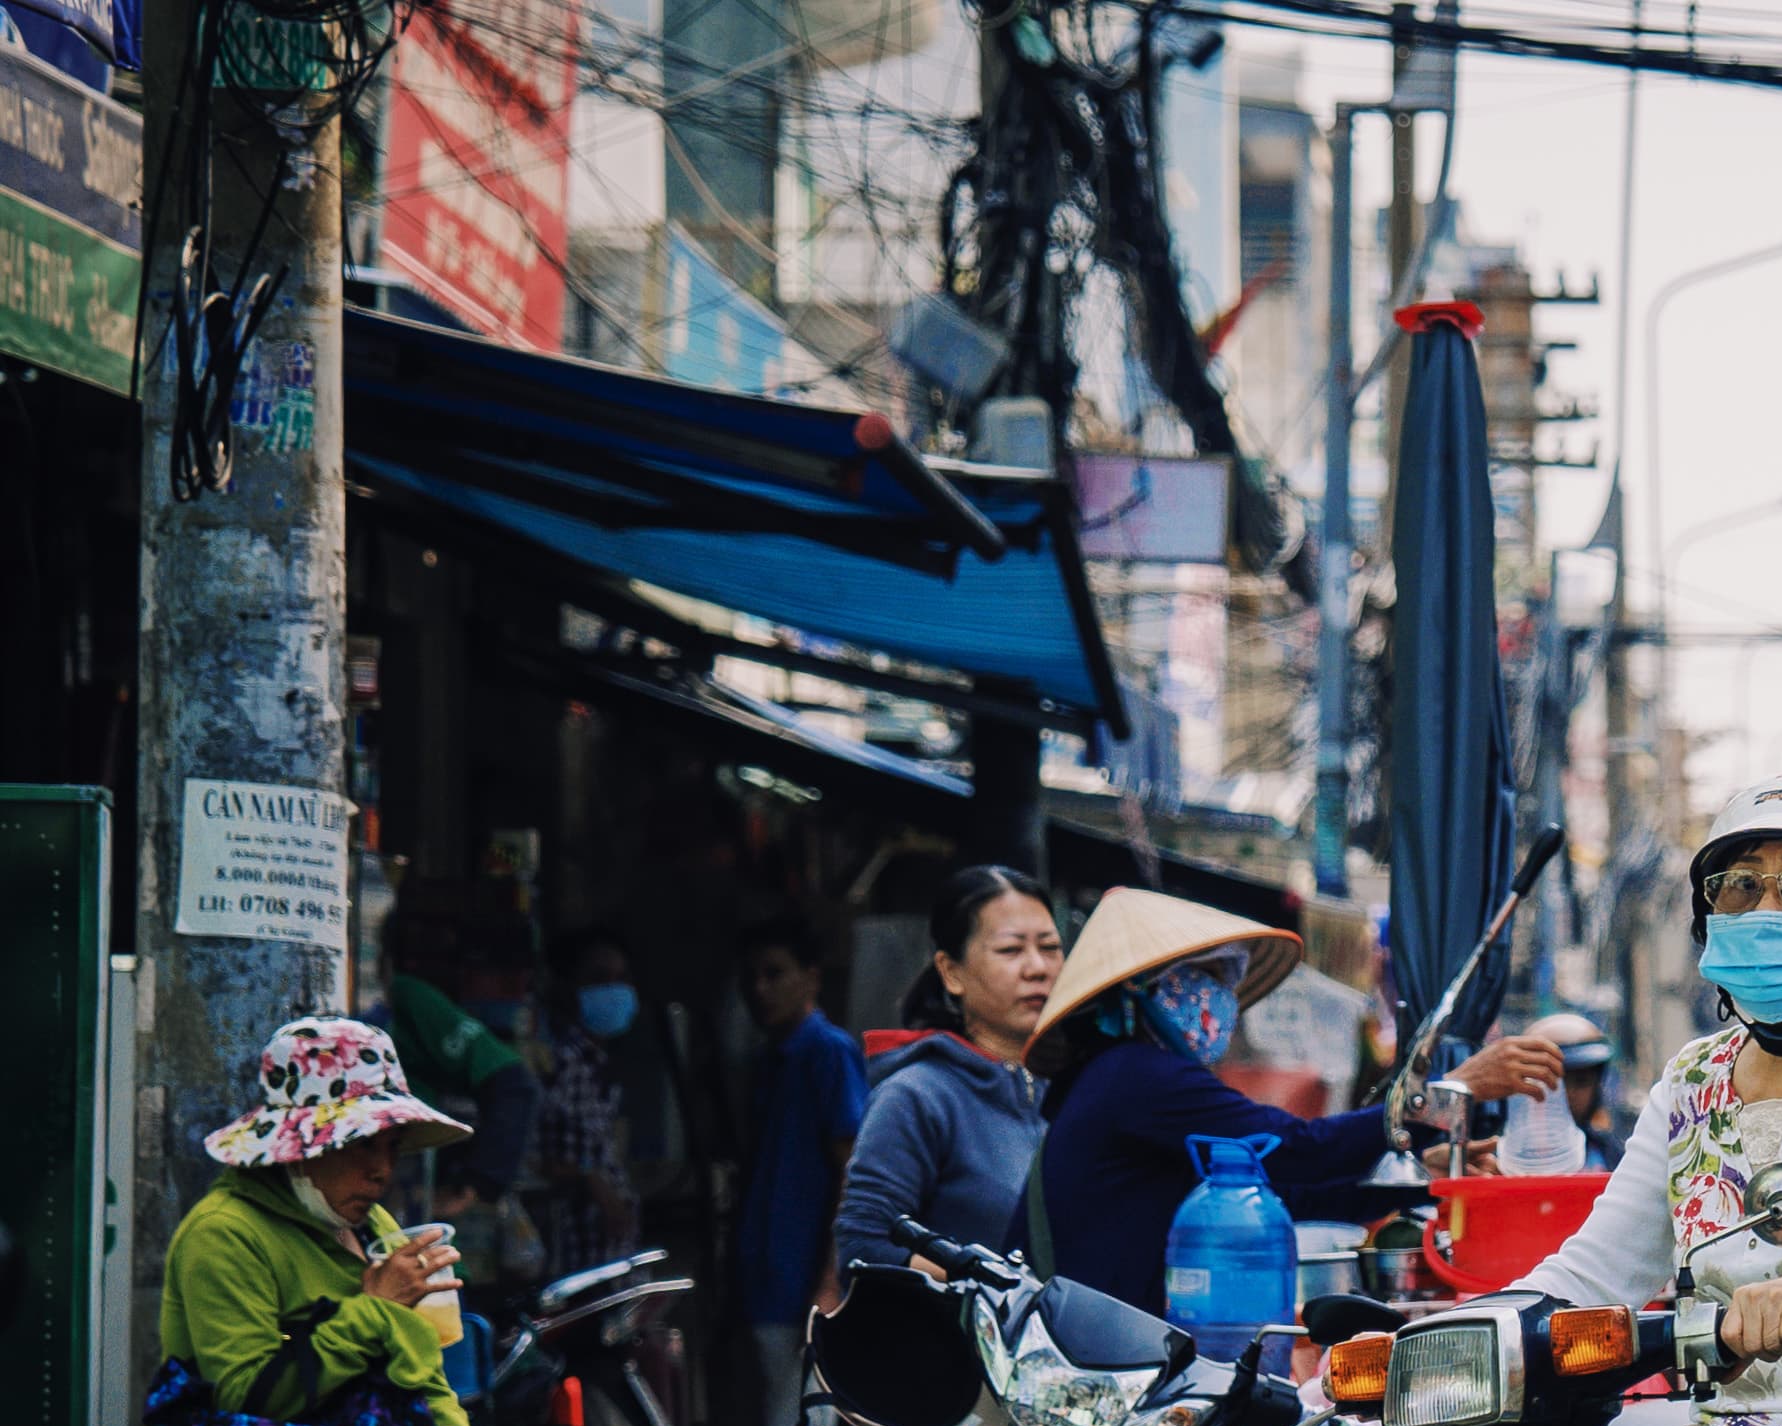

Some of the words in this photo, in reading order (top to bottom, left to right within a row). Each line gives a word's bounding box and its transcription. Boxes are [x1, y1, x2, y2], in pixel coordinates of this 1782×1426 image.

[250, 793, 294, 825] NAM
[240, 893, 290, 916] 0708
[295, 900, 325, 921] 496
